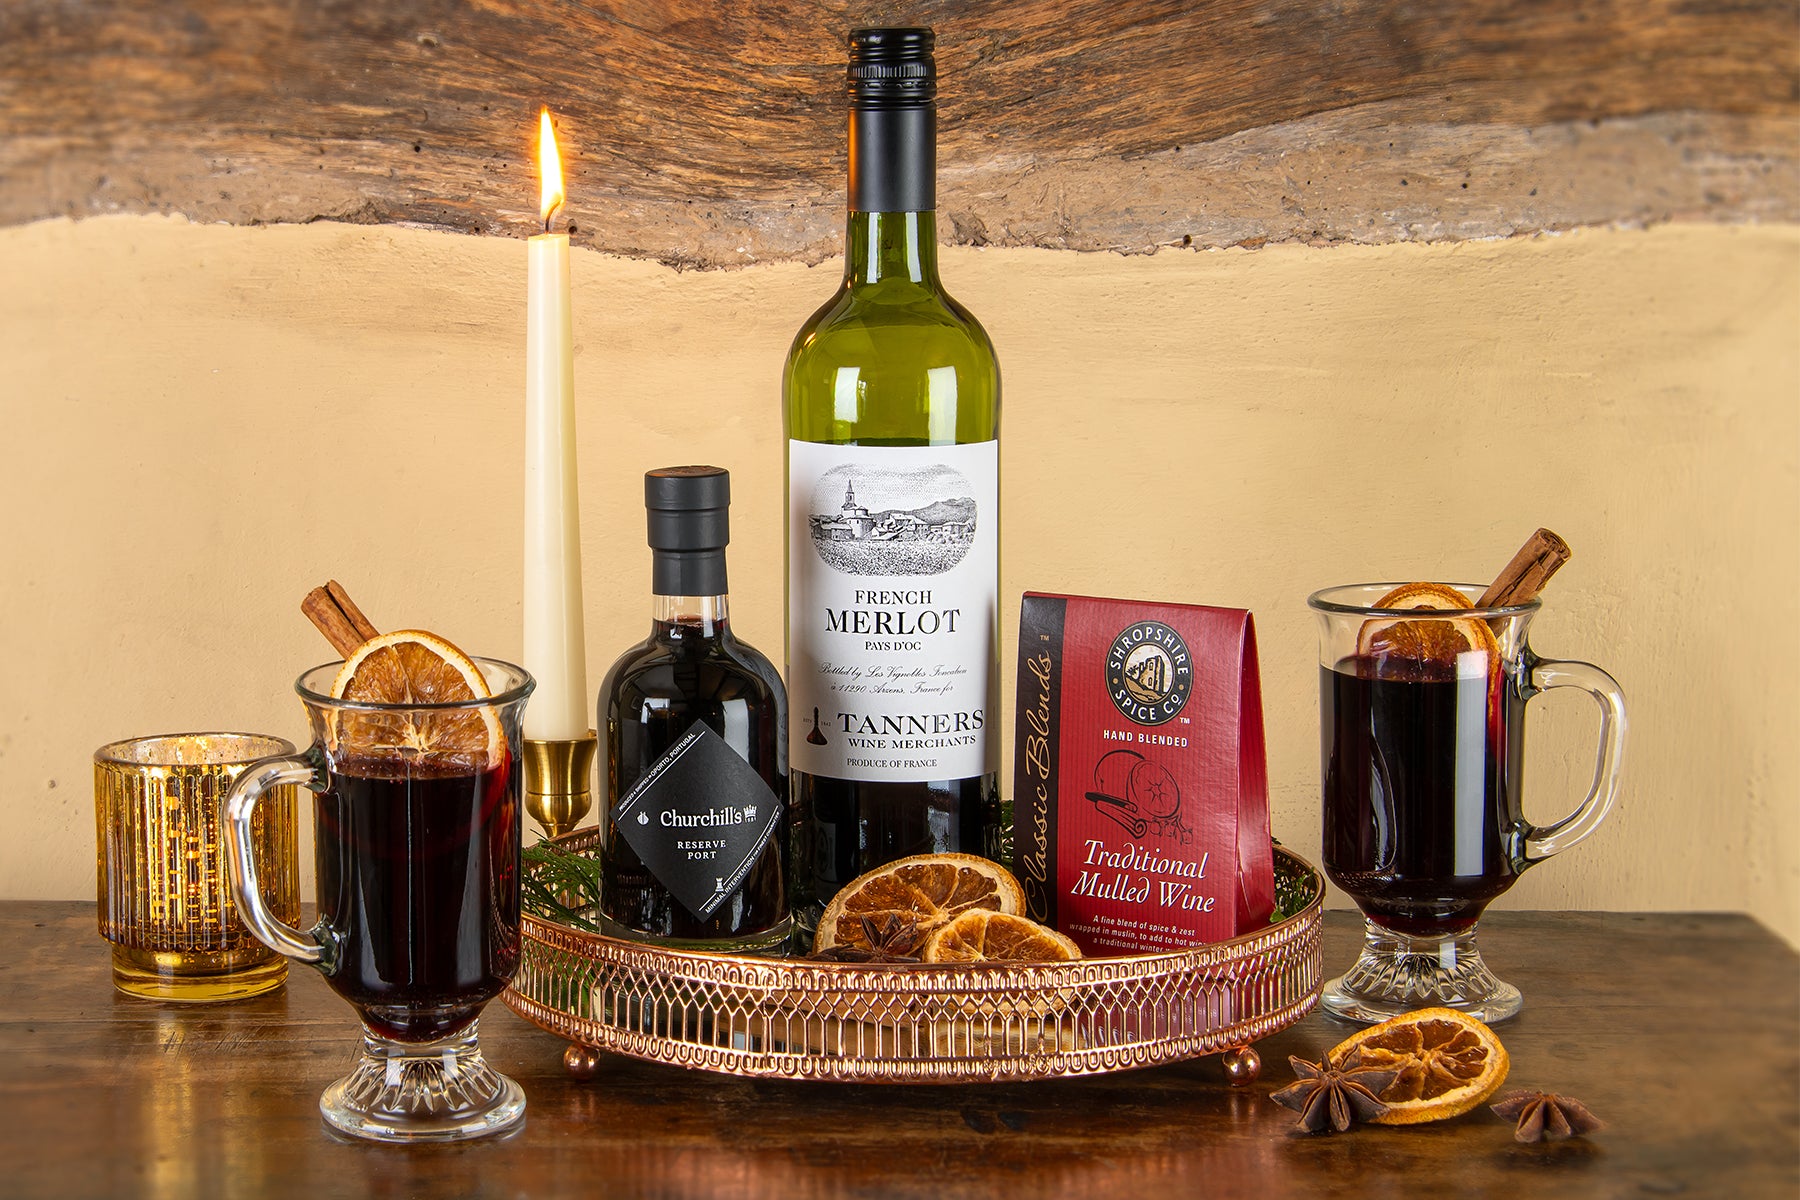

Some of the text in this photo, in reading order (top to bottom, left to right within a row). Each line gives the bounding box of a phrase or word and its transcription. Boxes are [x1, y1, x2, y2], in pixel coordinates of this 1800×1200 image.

[855, 590, 932, 605] FRENCH
[825, 607, 961, 635] MERLOT
[865, 641, 922, 651] PAYS D'OC
[1110, 626, 1189, 675] SHROPSHIRE
[818, 662, 851, 677] Bottled
[851, 667, 862, 681] by
[865, 665, 884, 678] Les
[887, 665, 926, 683] Vignobles
[839, 684, 867, 693] 11290
[910, 681, 940, 695] France
[939, 681, 954, 696] for
[1025, 650, 1052, 780] Blends
[1115, 689, 1157, 720] SPICE
[837, 709, 984, 735] TANNERS
[669, 733, 696, 758] PORTUGAL
[848, 735, 976, 749] WINE MERCHANTS
[1103, 729, 1188, 747] HAND BLENDED
[847, 758, 937, 768] PRODUCE OF FRANCE
[660, 807, 742, 827] Churchill's
[677, 840, 727, 849] RESERVE
[688, 851, 717, 860] PORT
[1023, 783, 1049, 923] Classic
[1083, 839, 1209, 879] Traditional
[705, 892, 726, 914] MINIMAL
[725, 856, 755, 893] INTERVENTION
[1071, 871, 1215, 912] Mulled Wine
[1069, 923, 1101, 934] wrapped
[1102, 926, 1110, 935] in
[1111, 928, 1137, 939] muslin,
[1139, 932, 1147, 941] to
[1149, 934, 1163, 943] add
[1165, 936, 1173, 944] to
[1175, 937, 1187, 946] hot
[1093, 915, 1196, 937] A fine blend of spice & zest
[1099, 938, 1138, 950] traditional
